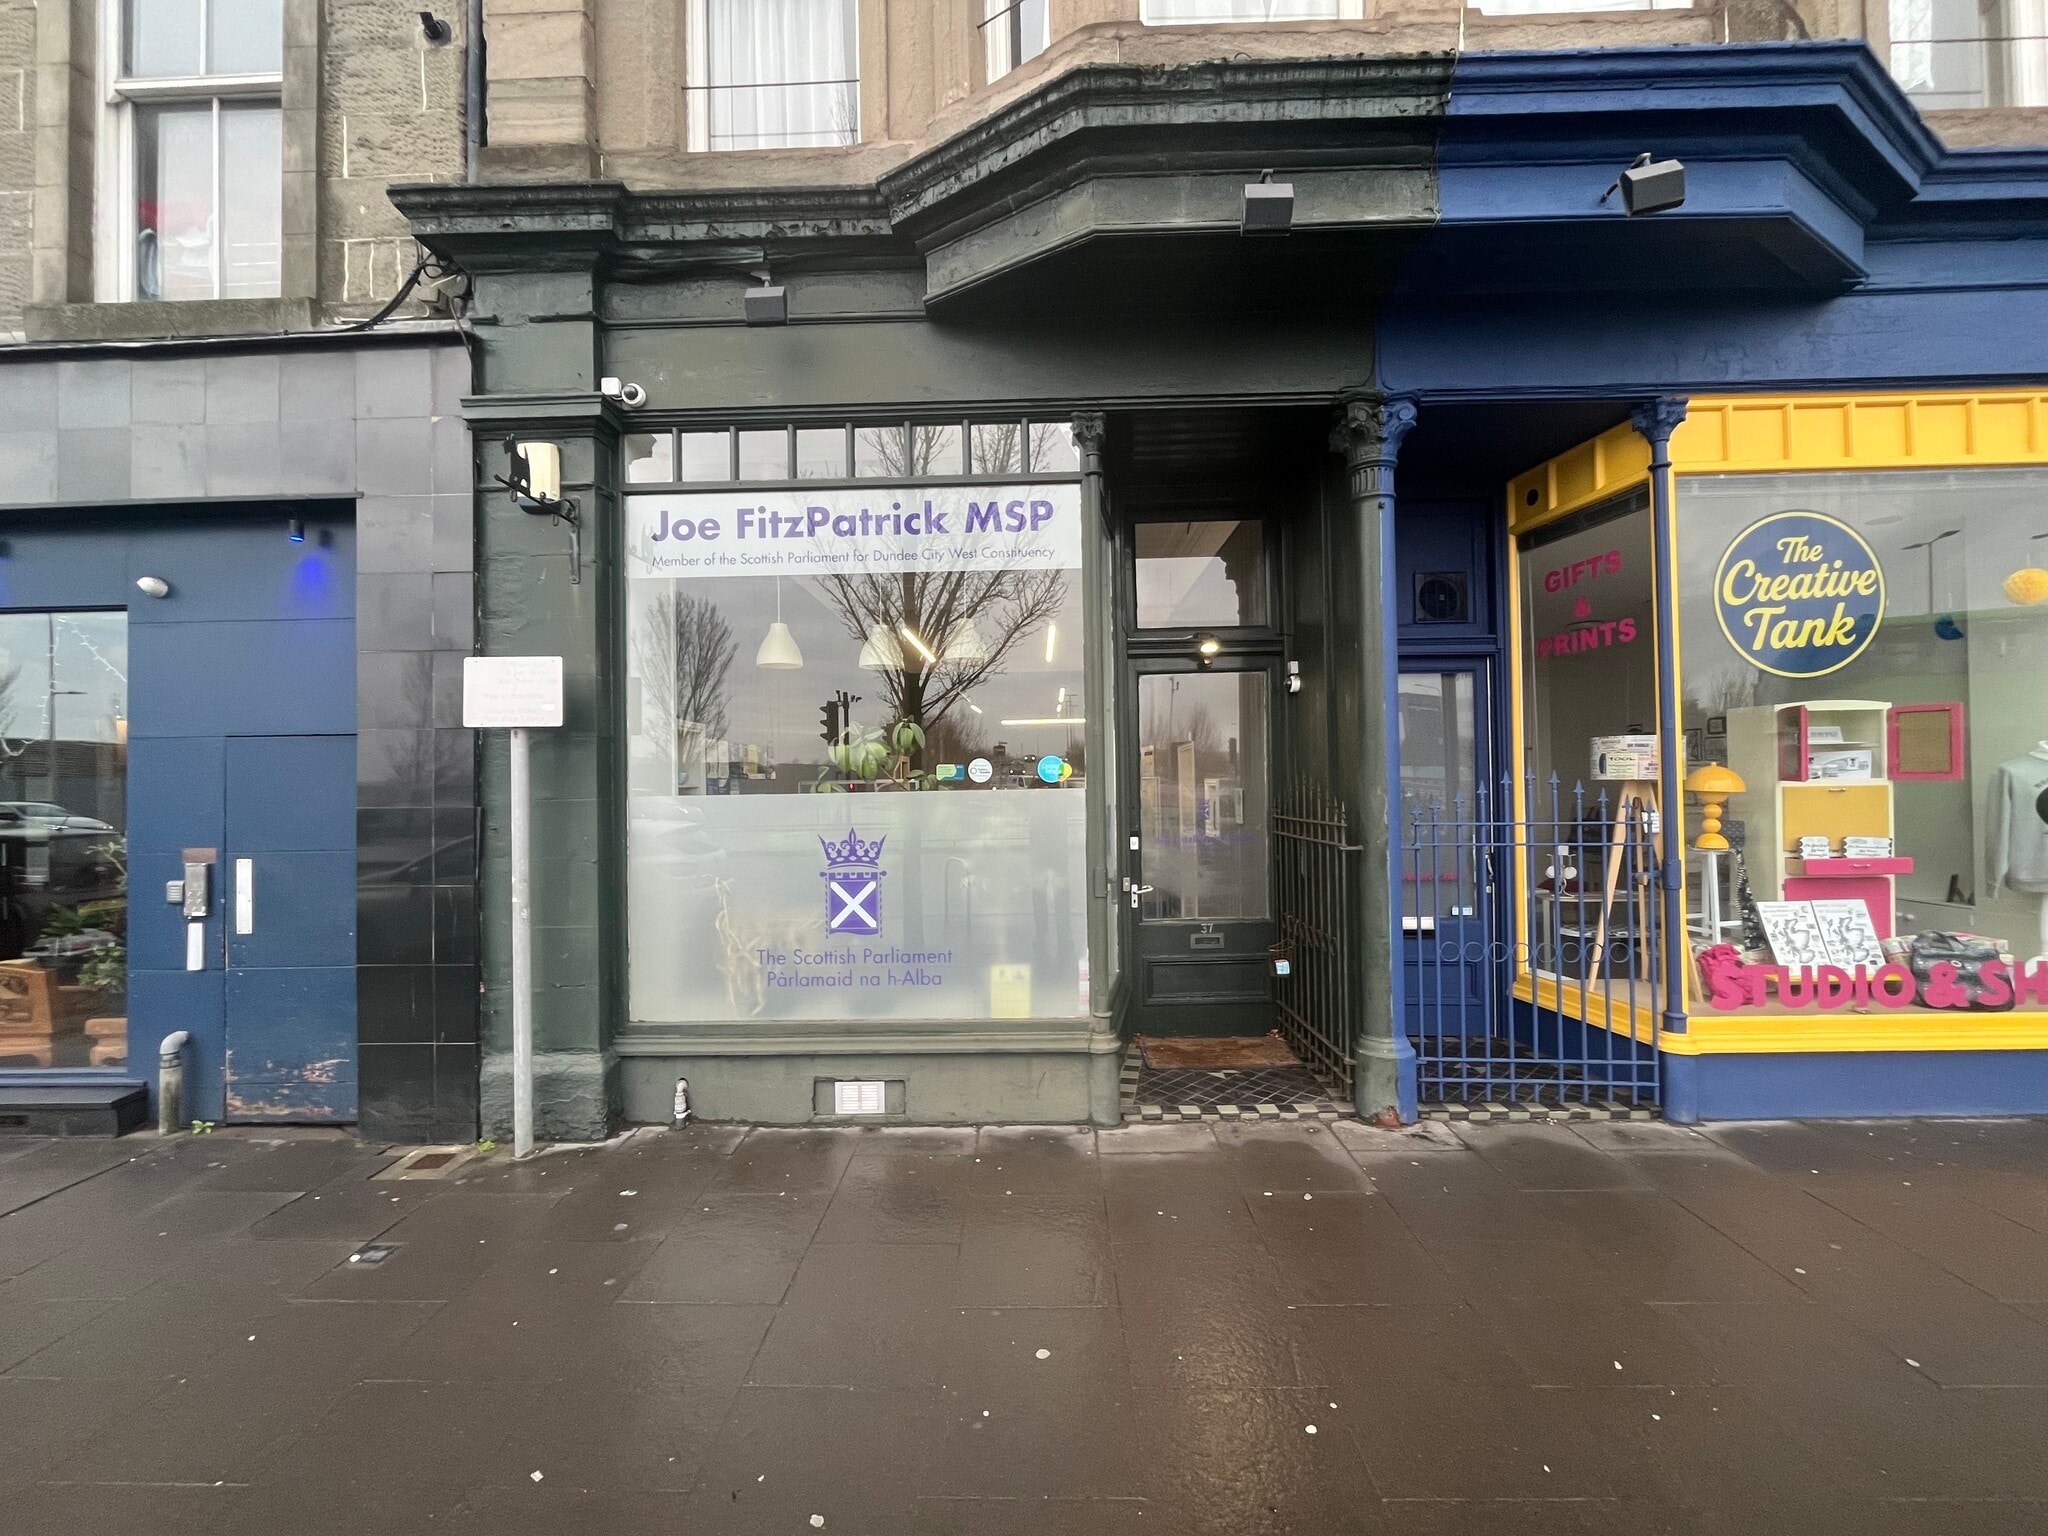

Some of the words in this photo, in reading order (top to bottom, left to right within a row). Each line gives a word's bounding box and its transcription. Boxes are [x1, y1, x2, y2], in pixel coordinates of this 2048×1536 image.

[651, 510, 721, 542] Joe
[736, 500, 950, 540] FitzPatrick
[964, 499, 1054, 534] MSP
[652, 553, 700, 567] Member
[704, 552, 716, 566] of
[719, 552, 736, 565] the
[740, 551, 783, 565] Scottish
[788, 550, 850, 564] Parliament
[853, 548, 869, 562] for
[873, 547, 918, 562] Dundee
[921, 547, 944, 563] City
[949, 547, 977, 560] West
[981, 546, 1055, 561] Constituency
[1776, 535, 1824, 564] The
[1544, 550, 1623, 593] GIFTS
[1722, 558, 1878, 606] Creative
[1537, 616, 1637, 659] PRINTS
[1743, 601, 1857, 651] Tank
[1200, 923, 1214, 934] 37
[756, 949, 786, 966] The
[793, 948, 856, 965] Scottish
[863, 948, 953, 965] Parliament
[767, 969, 853, 987] Pàrlamaid
[859, 974, 881, 986] na
[887, 968, 942, 986] h-Alba
[1709, 962, 1917, 1011] STUDIO
[1923, 960, 1970, 1009] &
[1977, 960, 2048, 1006] SH
